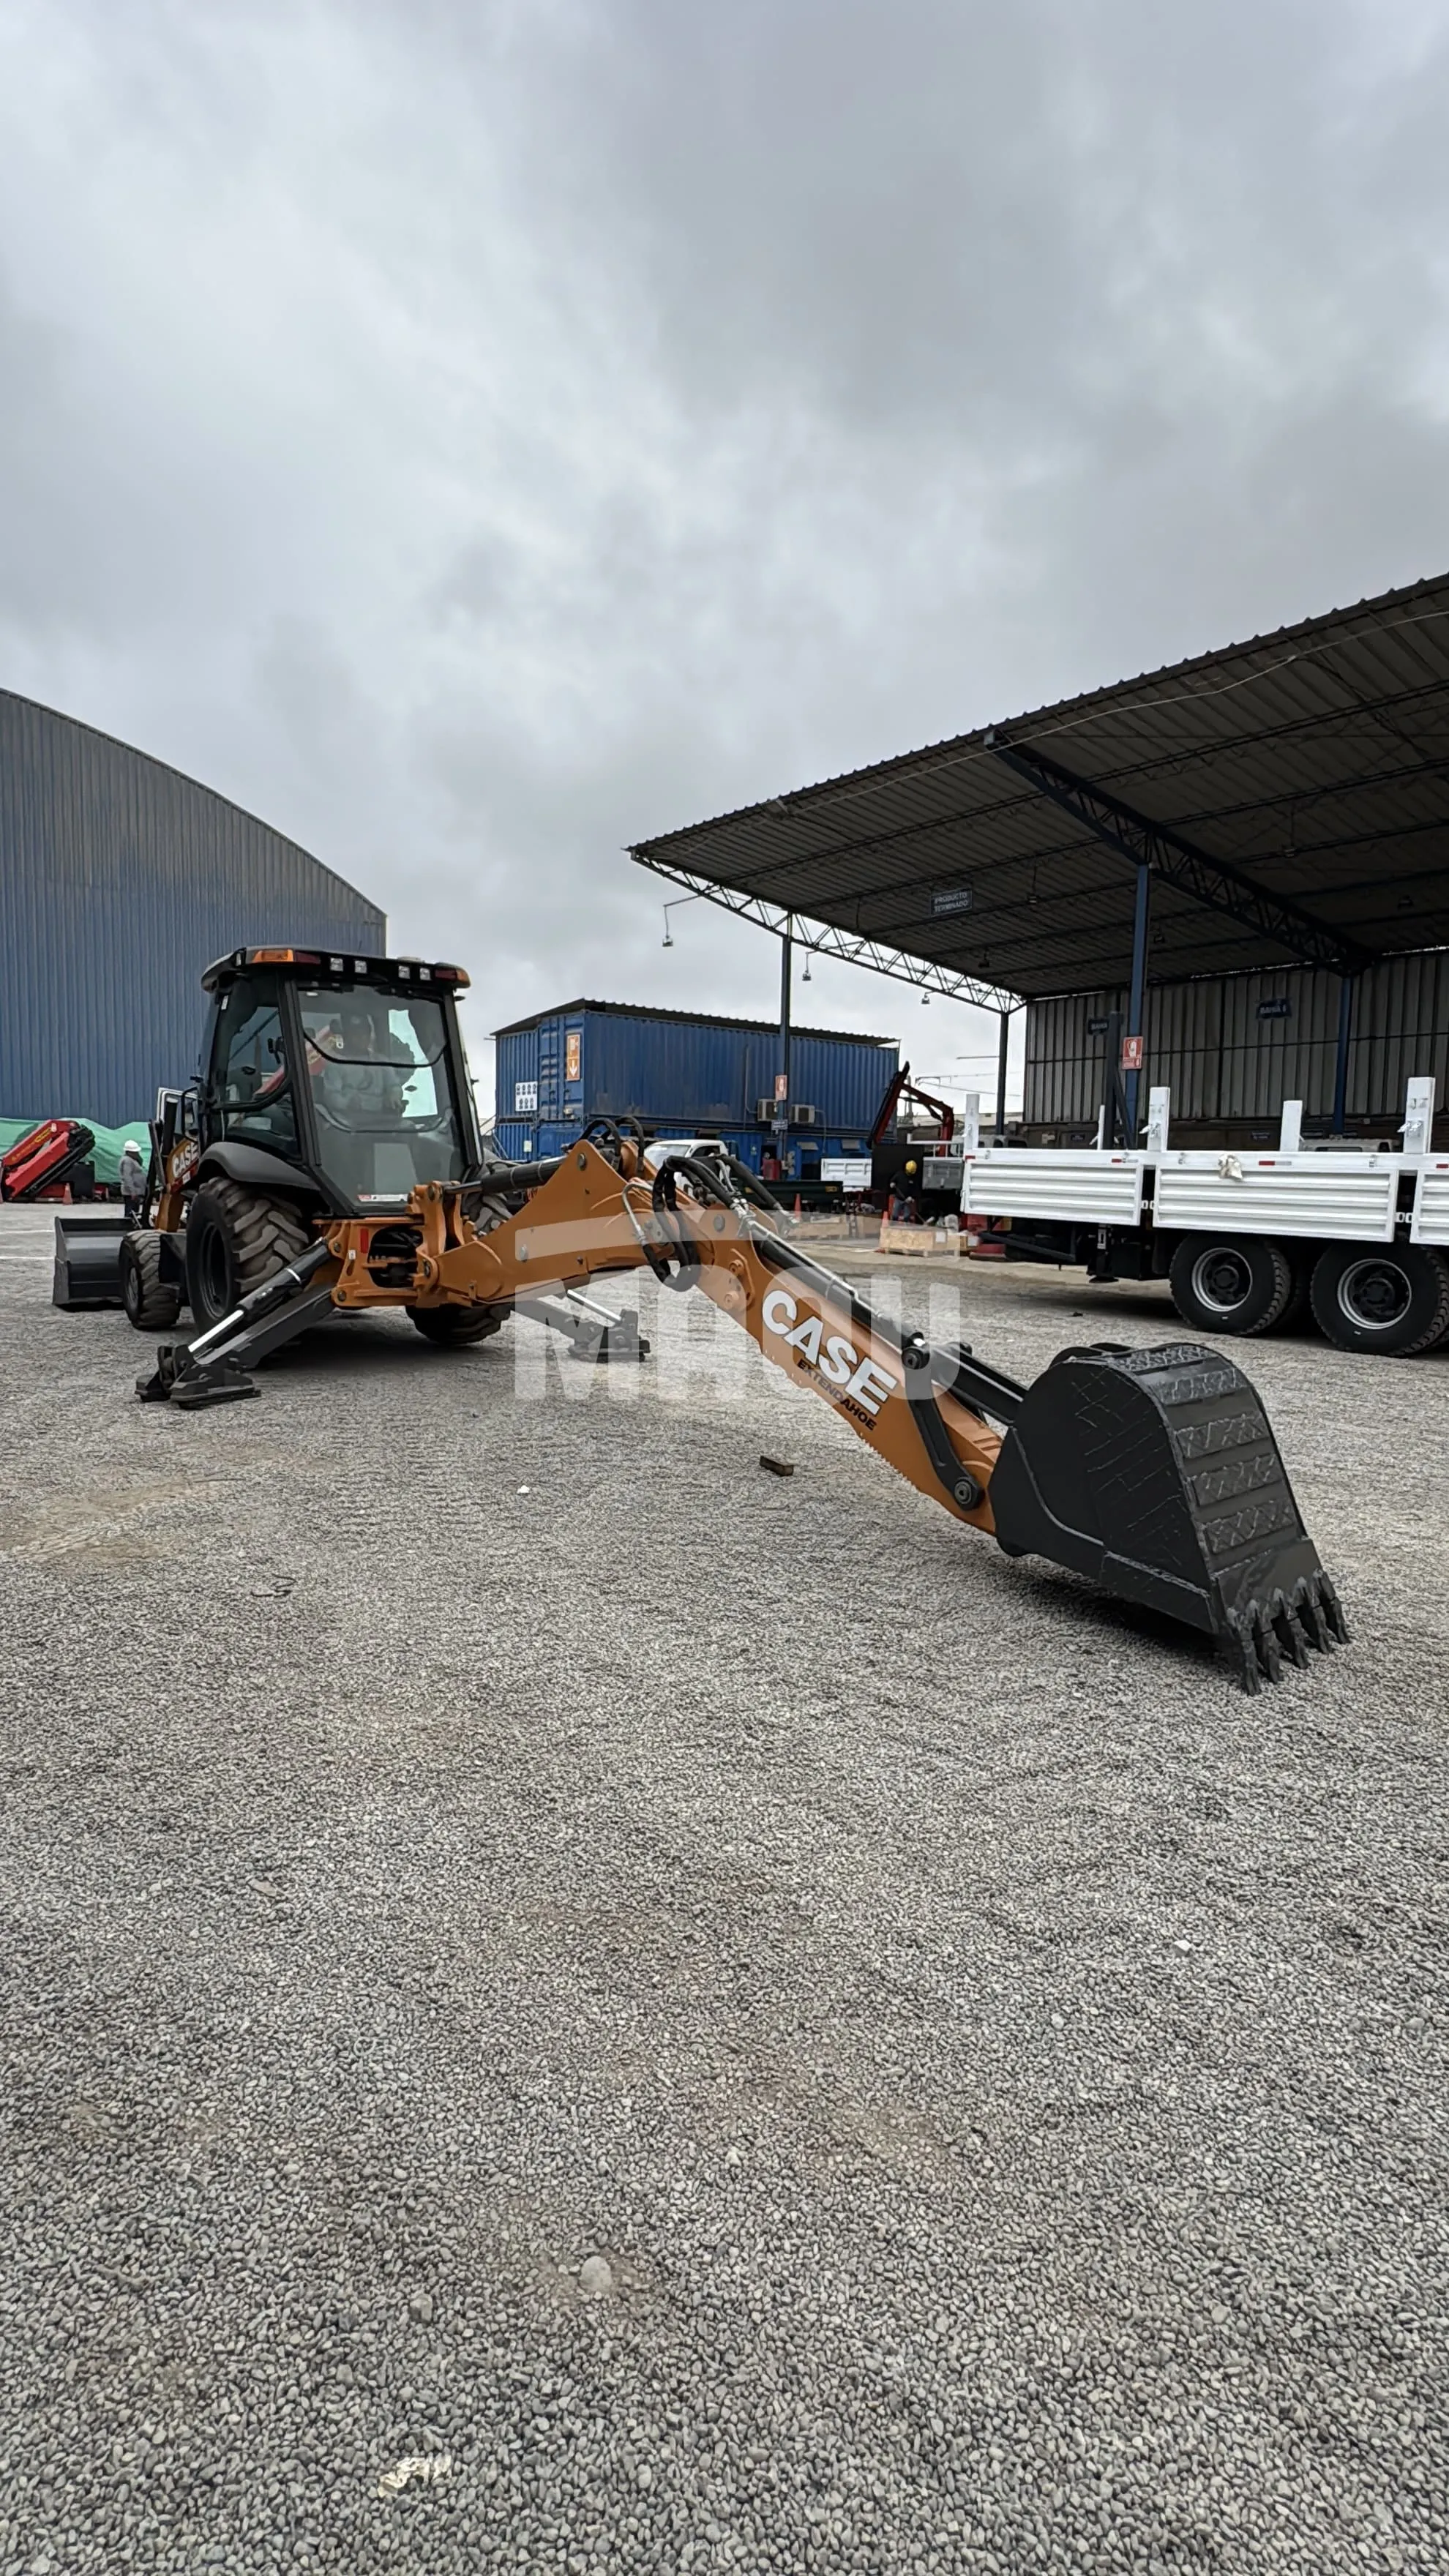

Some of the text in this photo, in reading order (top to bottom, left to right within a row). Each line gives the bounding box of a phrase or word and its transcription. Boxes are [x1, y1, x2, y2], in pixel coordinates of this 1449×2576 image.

[934, 900, 968, 912] TERMINADO
[935, 892, 967, 904] PRODUCTO
[172, 1142, 199, 1177] CASE
[762, 1289, 898, 1417] CASE
[797, 1358, 877, 1431] EXTENDAHOE
